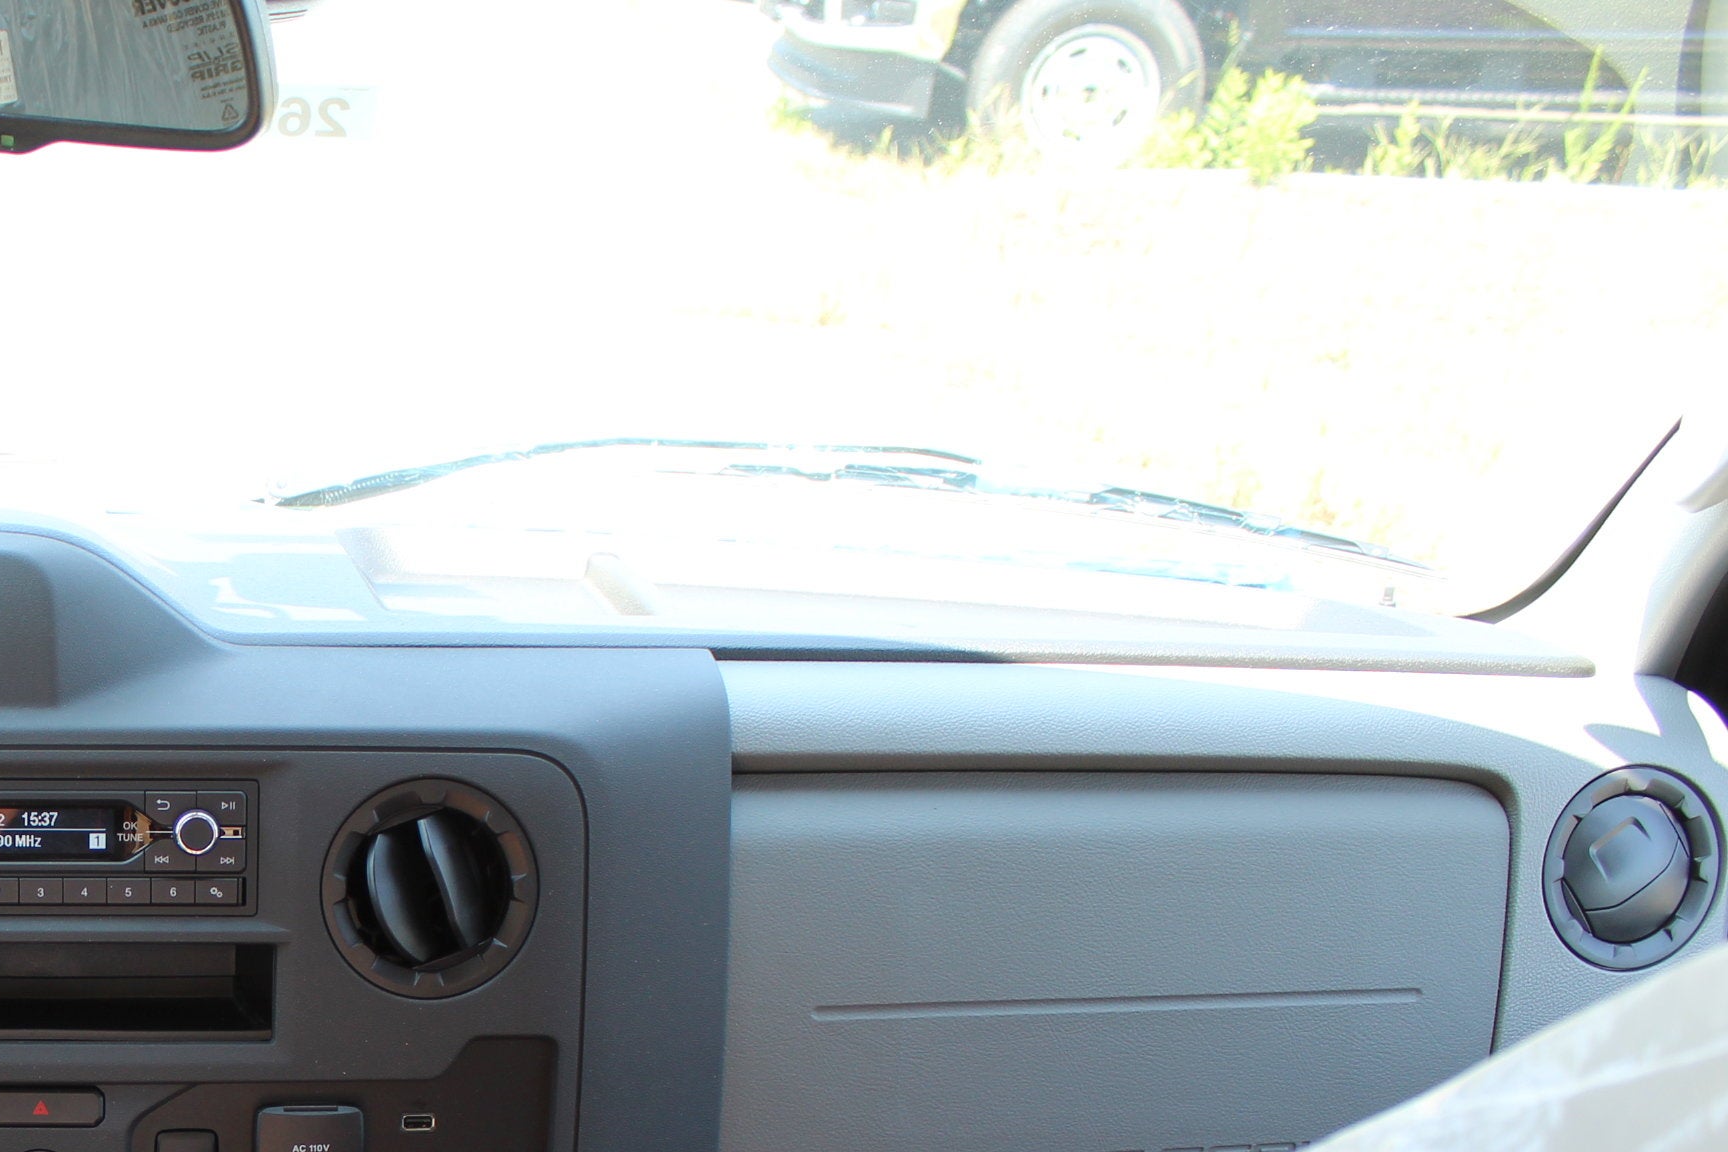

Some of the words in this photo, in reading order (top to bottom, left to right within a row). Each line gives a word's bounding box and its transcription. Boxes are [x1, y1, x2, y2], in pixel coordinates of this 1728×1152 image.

[22, 811, 58, 827] 15:37
[123, 821, 138, 830] OK
[15, 834, 41, 848] MHz
[117, 832, 144, 843] TUNE
[37, 887, 44, 897] 3
[80, 887, 88, 897] 4
[124, 887, 132, 897] 5
[169, 887, 177, 897] 6
[292, 1144, 306, 1152] AC
